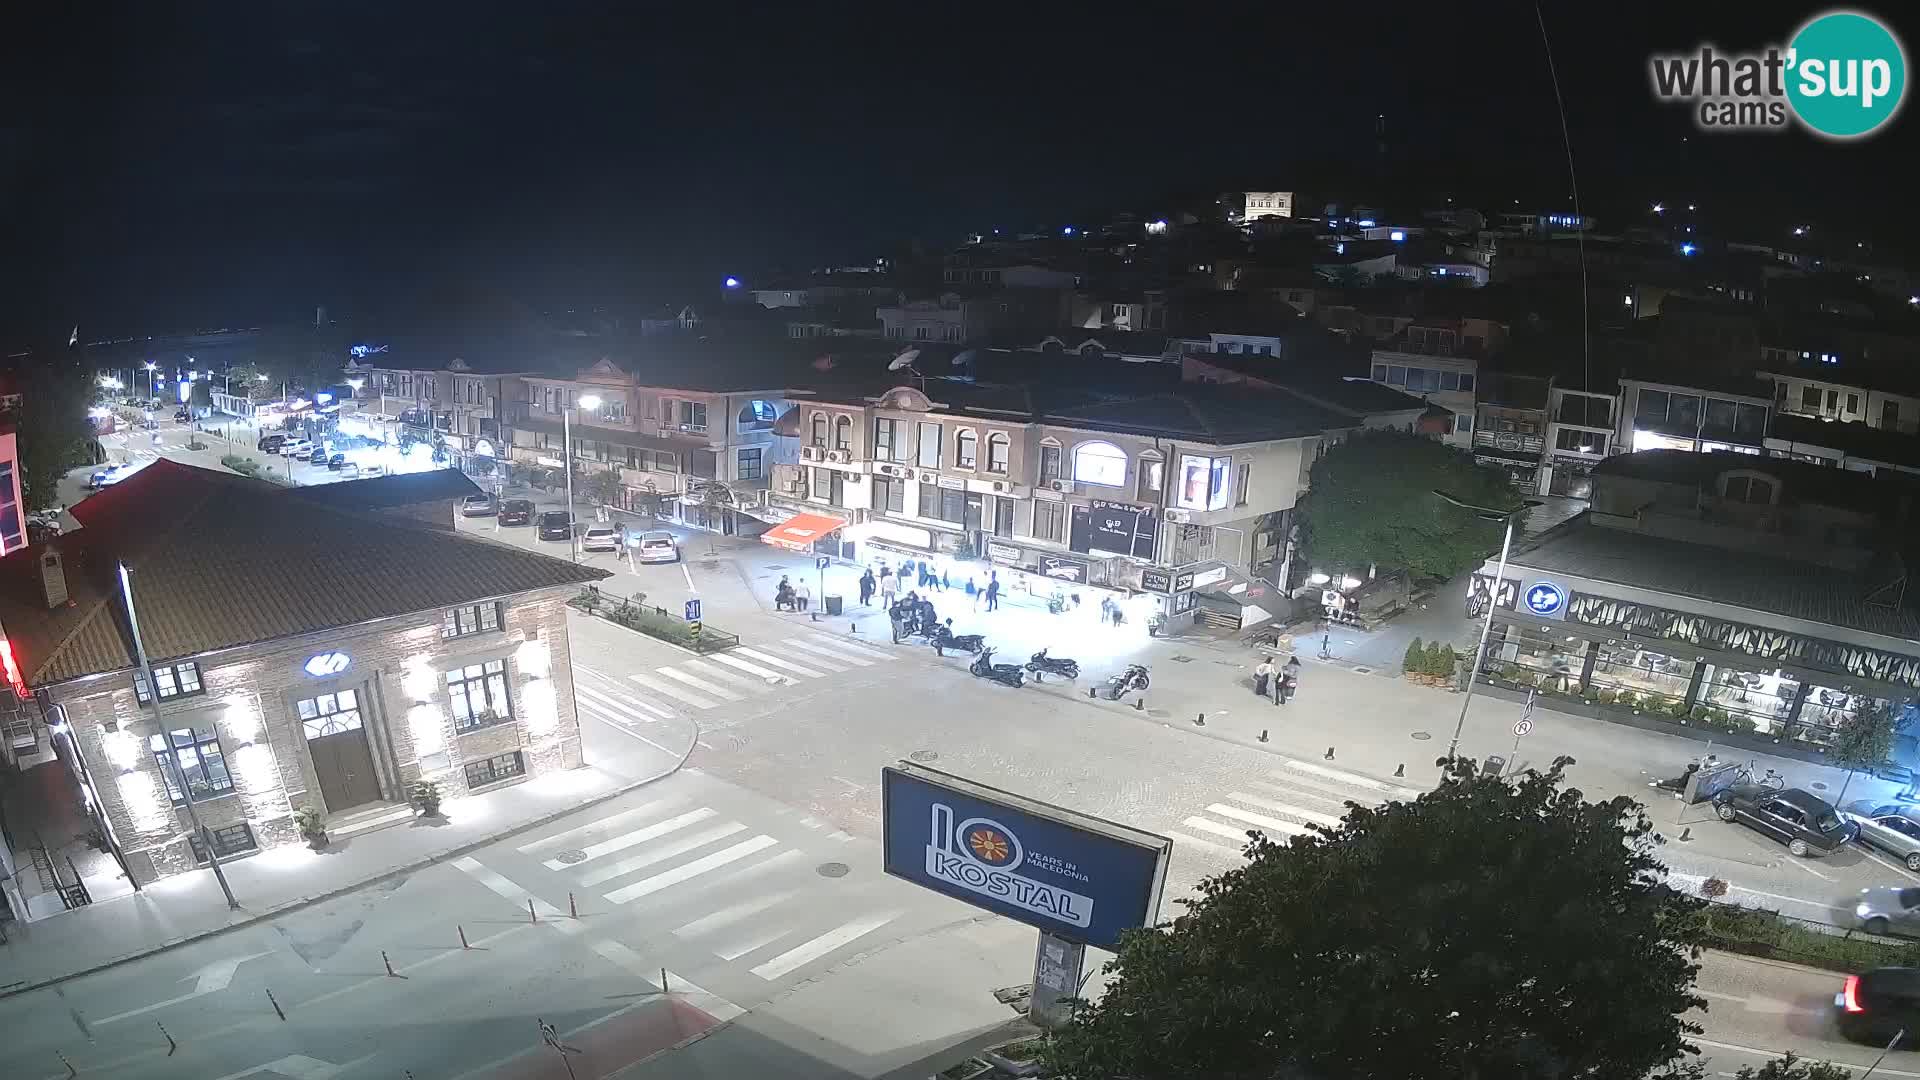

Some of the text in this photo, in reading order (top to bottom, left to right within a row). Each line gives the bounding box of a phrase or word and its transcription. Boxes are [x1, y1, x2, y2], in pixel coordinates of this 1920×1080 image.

[819, 558, 828, 569] P
[931, 802, 1024, 873] 10
[1027, 857, 1089, 883] MACEDONIA
[1028, 850, 1077, 871] YEARS IN
[935, 851, 1080, 921] KOSTAL
